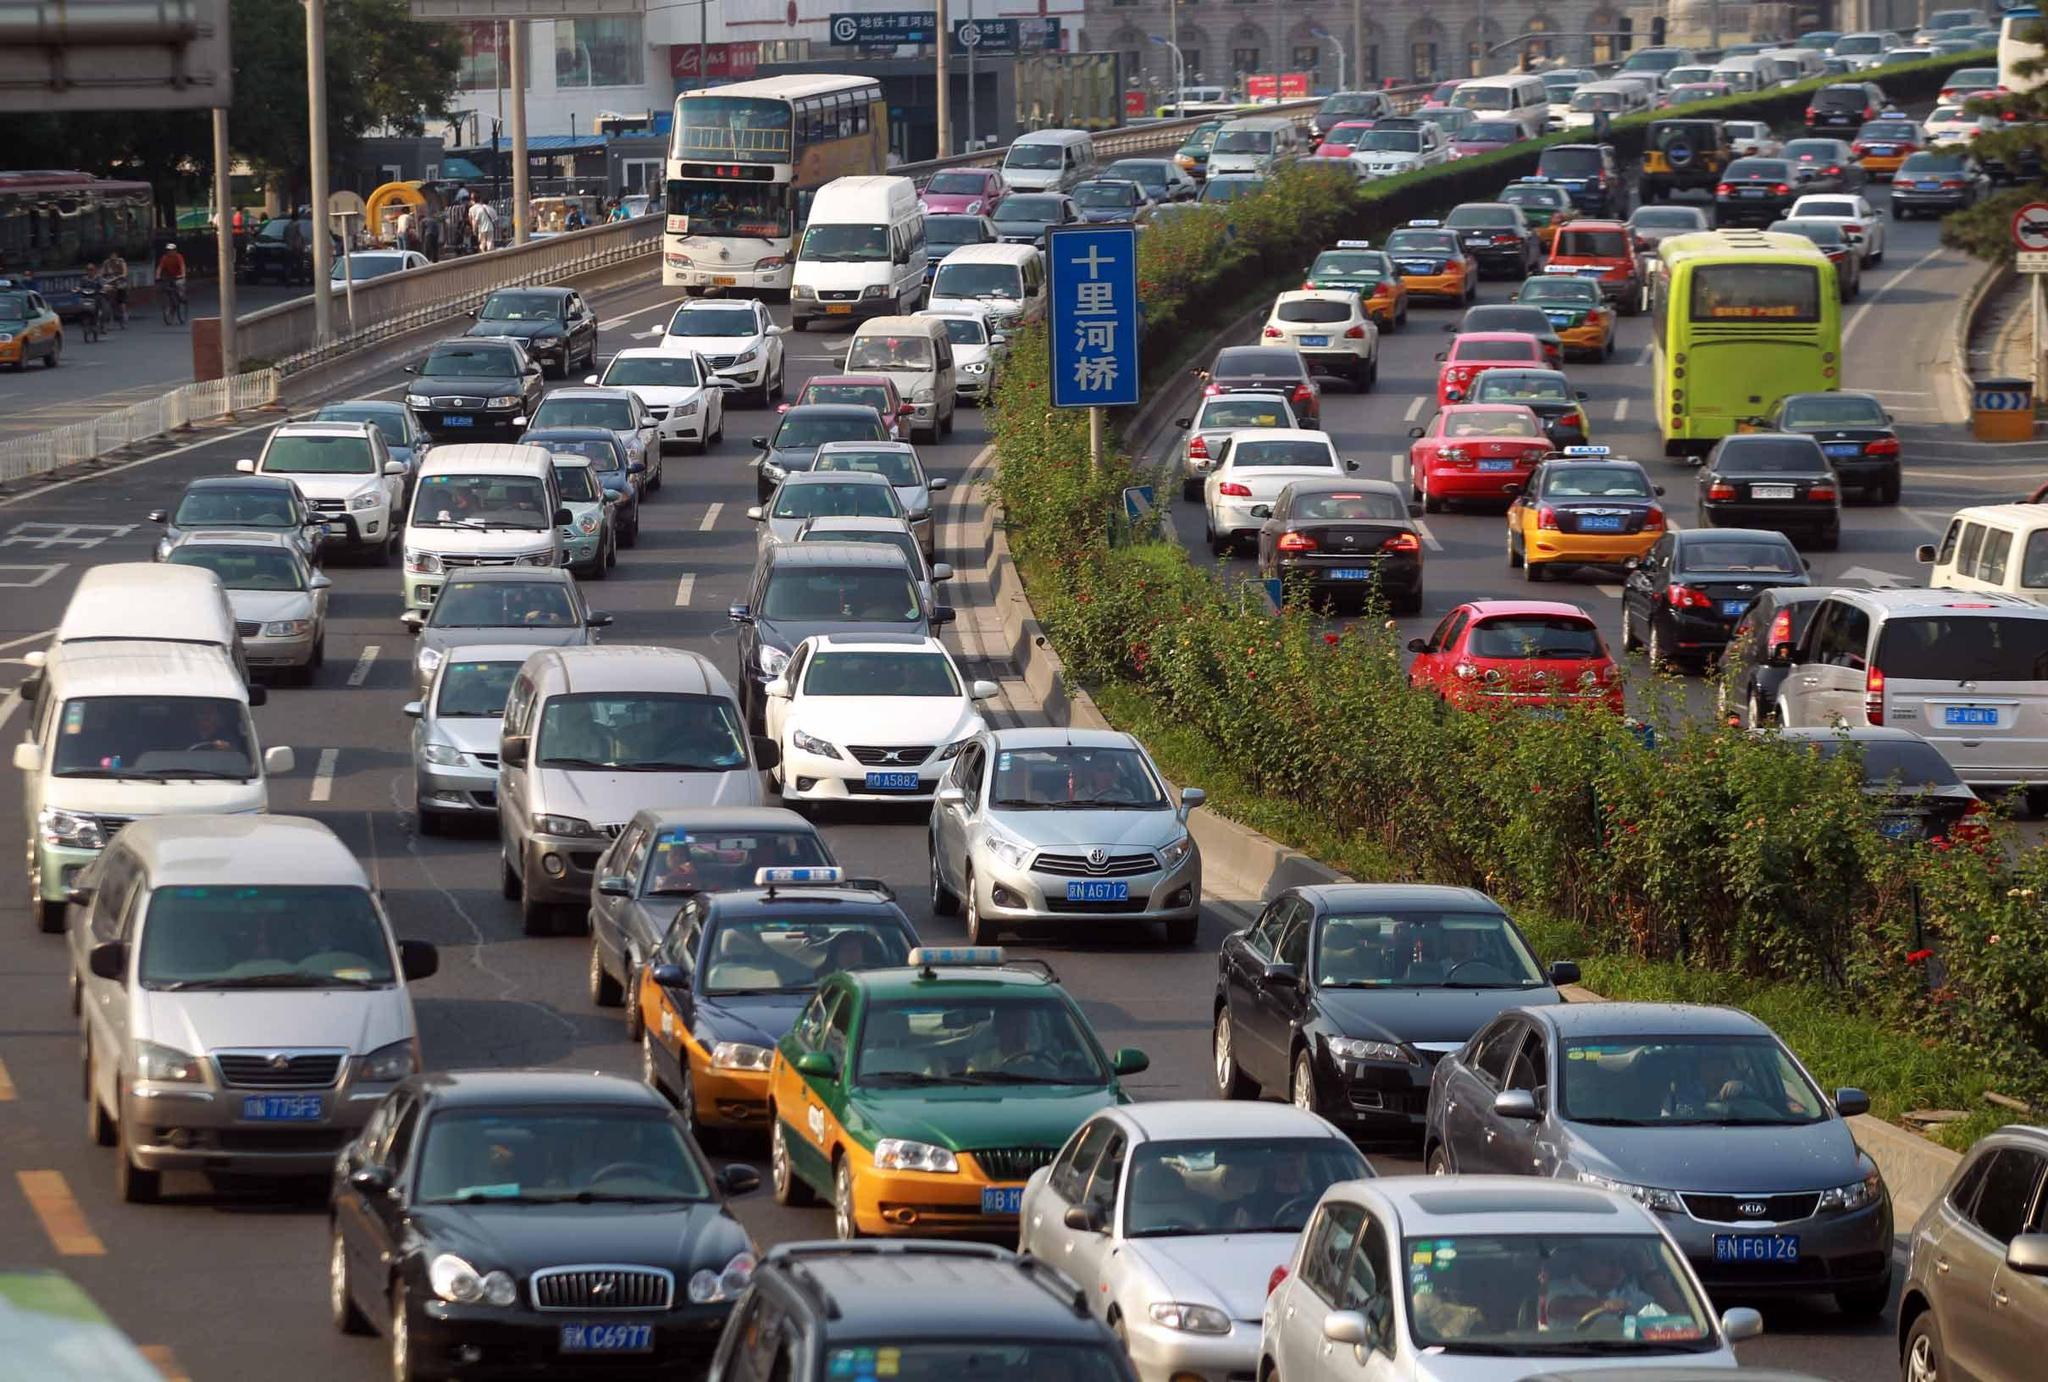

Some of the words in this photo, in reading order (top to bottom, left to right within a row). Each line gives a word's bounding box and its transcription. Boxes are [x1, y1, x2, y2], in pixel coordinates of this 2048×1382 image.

[1071, 245, 1118, 391] 十里河桥
[1744, 1204, 1762, 1213] KIA
